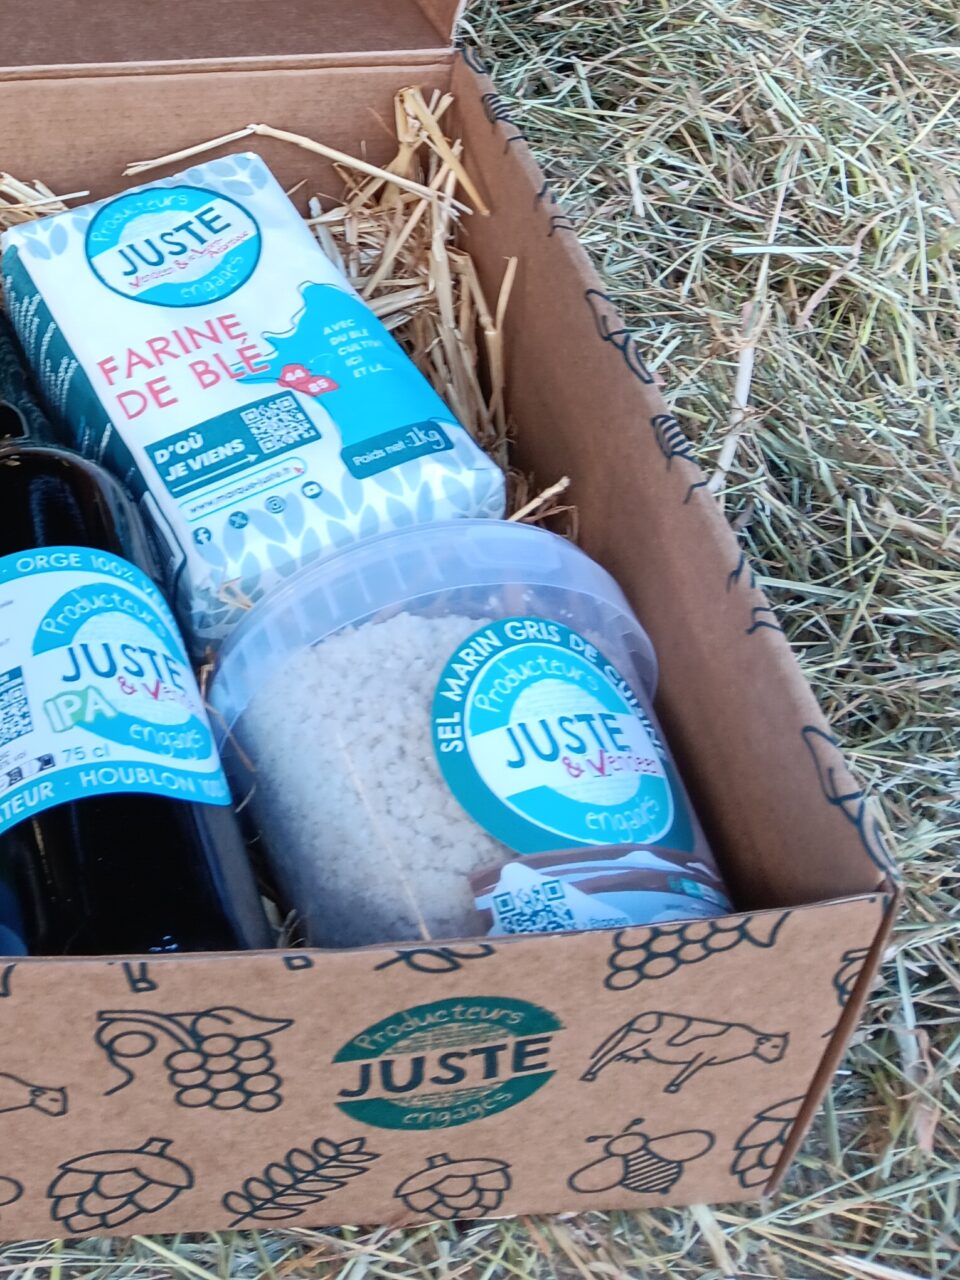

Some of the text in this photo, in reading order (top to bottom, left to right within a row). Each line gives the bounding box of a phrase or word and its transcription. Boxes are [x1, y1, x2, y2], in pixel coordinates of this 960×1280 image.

[118, 206, 232, 276] JUSTE
[323, 318, 356, 336] AVEC
[96, 313, 249, 386] FARINE
[116, 337, 271, 420] DE BLÉ
[308, 379, 329, 393] 85
[154, 431, 204, 465] D'OÙ
[165, 438, 246, 482] JE VIENS
[352, 449, 387, 466] Poids
[15, 552, 83, 572] ORGE
[504, 620, 561, 643] GRIS
[569, 633, 599, 663] DE
[62, 642, 187, 692] JUSTE
[439, 629, 504, 703] MARIN
[43, 686, 119, 734] IPA
[61, 742, 111, 763] 75 cl
[435, 711, 463, 754] SEL
[506, 712, 631, 770] JUSTE
[79, 766, 196, 793] HOUBLON
[352, 1003, 526, 1050] Producteurs
[336, 1035, 554, 1098] JUSTE
